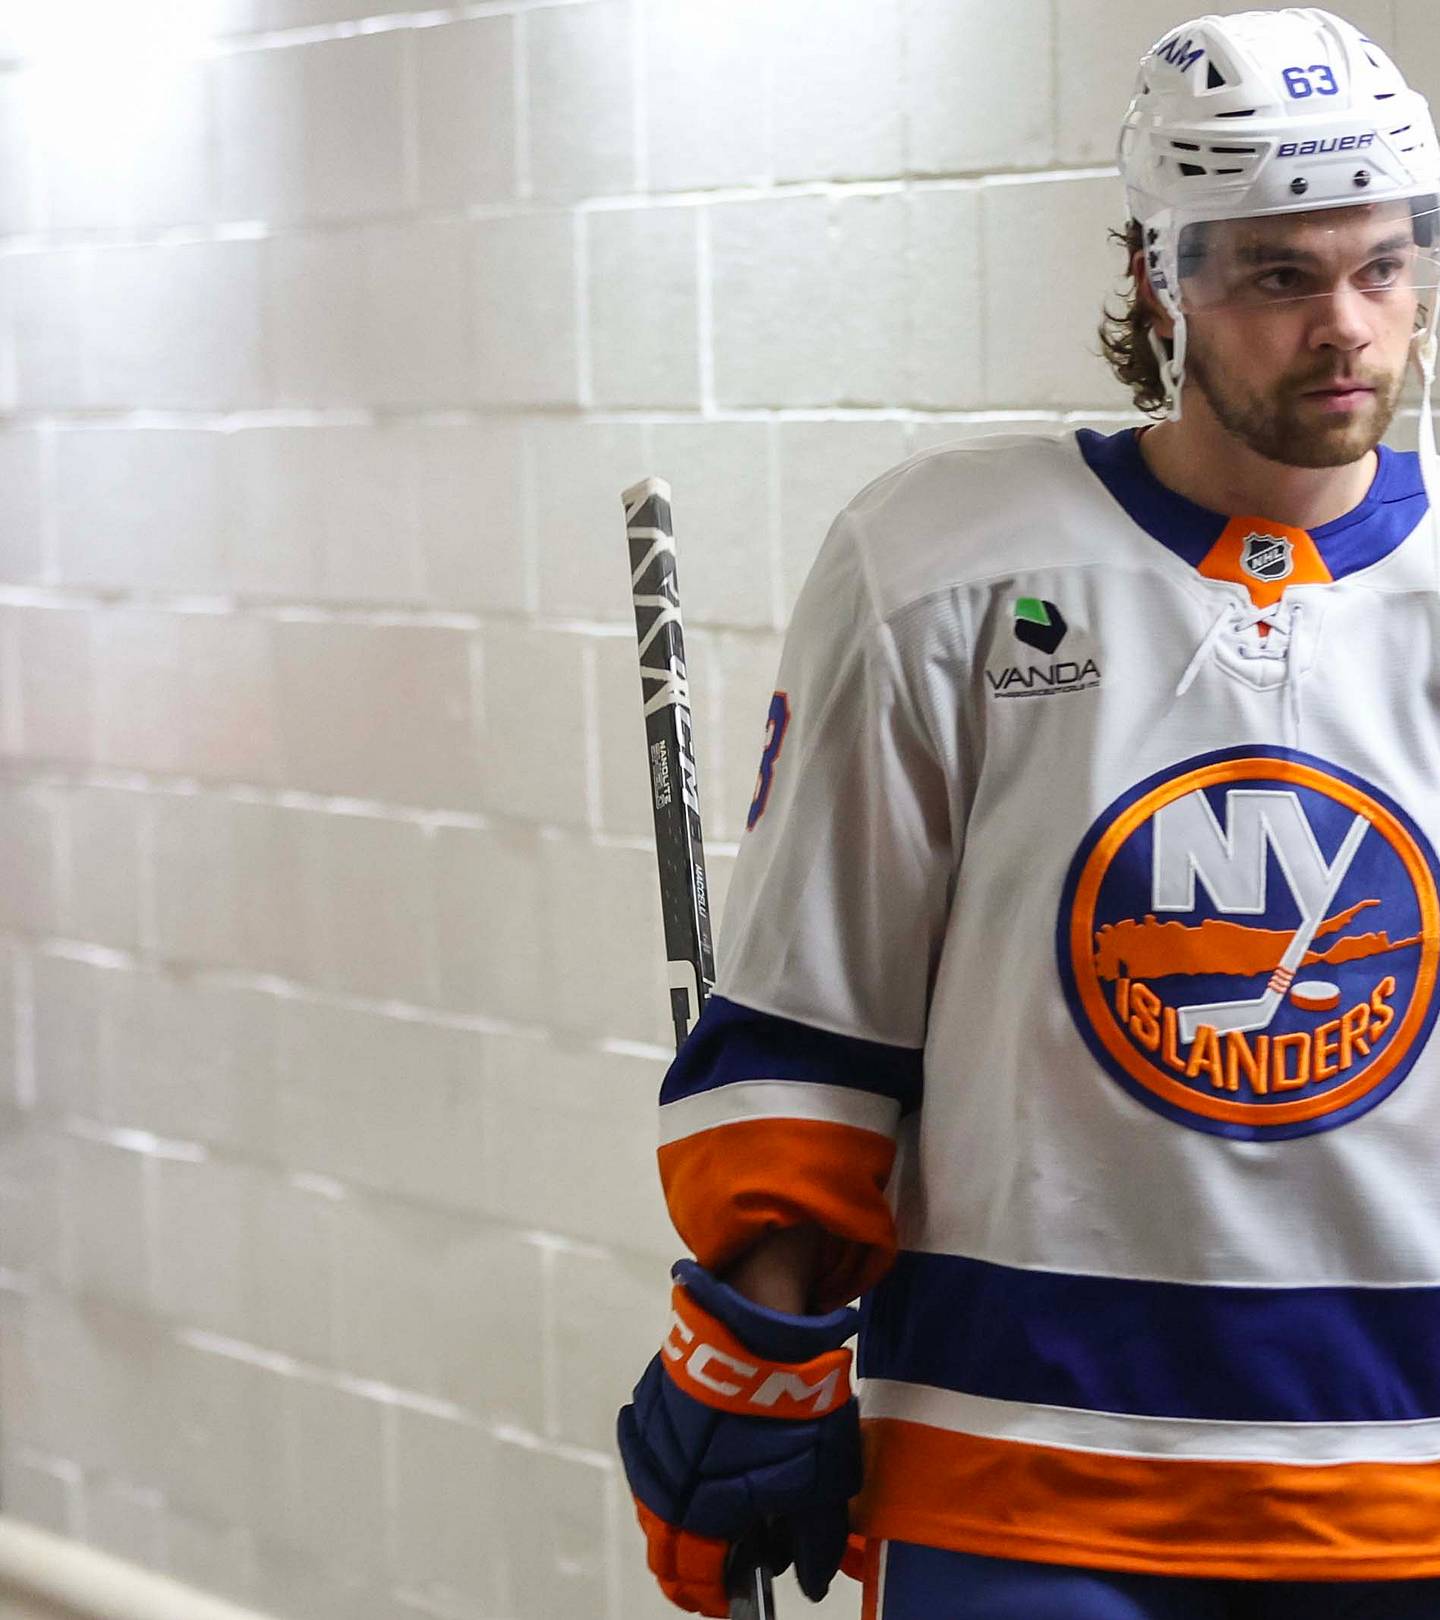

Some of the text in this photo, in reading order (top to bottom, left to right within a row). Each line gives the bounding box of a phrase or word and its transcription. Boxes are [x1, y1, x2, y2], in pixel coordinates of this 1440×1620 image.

[1282, 64, 1339, 99] 63
[1276, 132, 1376, 159] BAUER
[985, 659, 1101, 690] VANDA
[1152, 788, 1372, 930] NY
[694, 863, 707, 918] MACCELLI
[1114, 974, 1396, 1095] ISLANDERS
